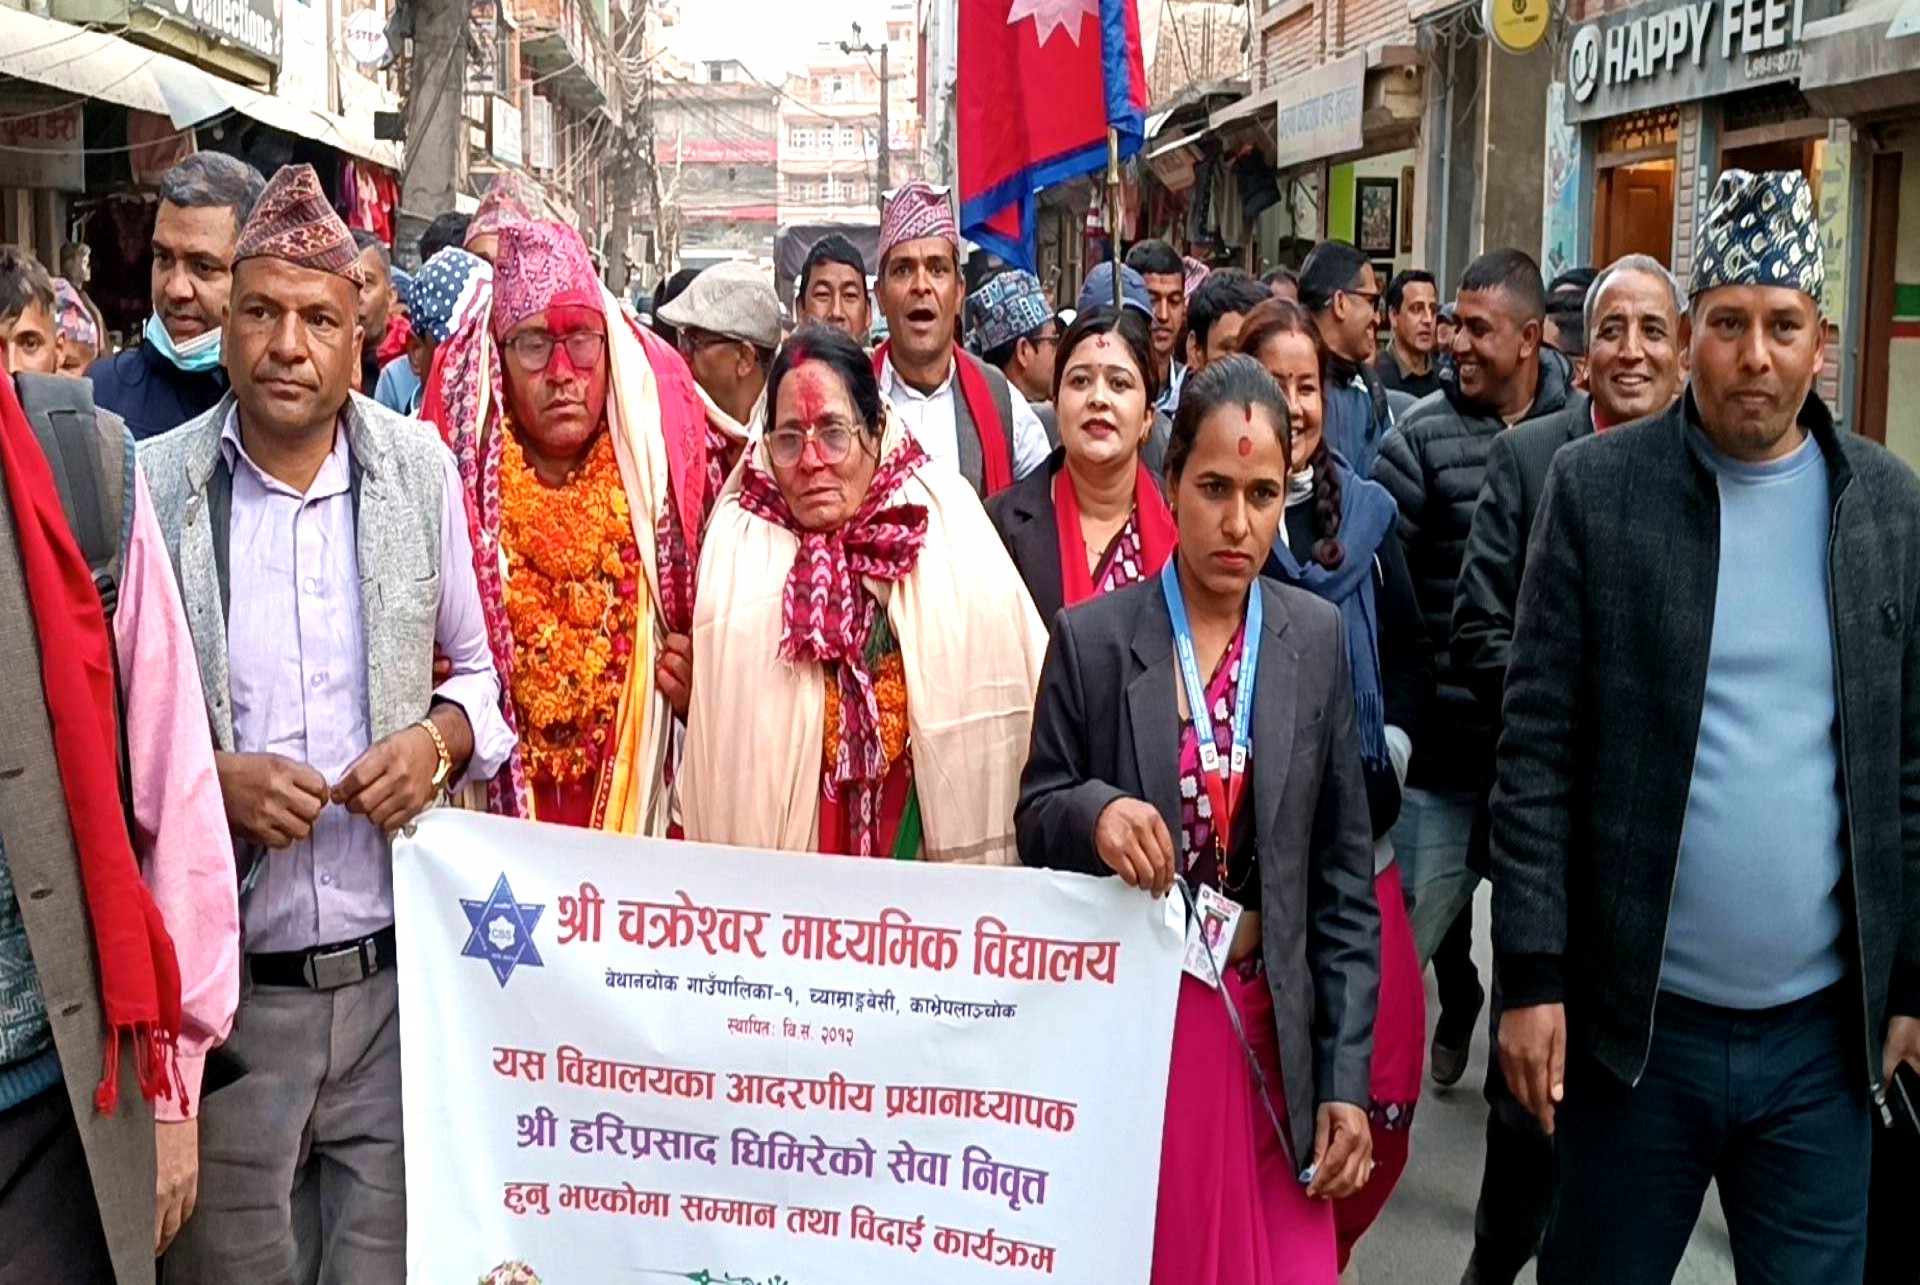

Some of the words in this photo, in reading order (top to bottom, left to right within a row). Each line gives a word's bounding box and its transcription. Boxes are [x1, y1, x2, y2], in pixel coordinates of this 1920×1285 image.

[1604, 2, 1712, 85] HAPPY
[1722, 0, 1803, 58] FEET
[557, 882, 605, 945] श्री
[618, 889, 770, 958] चक्रेश्वर
[782, 907, 962, 972] माध्यमिक
[974, 916, 1120, 984] विद्यालय
[821, 1026, 854, 1046] २०१२
[493, 1046, 546, 1082] यस
[556, 1045, 716, 1100] विद्यालयका
[726, 1072, 875, 1112] आदरणीय
[886, 1084, 1078, 1132] प्रधानाध्यापक
[516, 1106, 559, 1148] श्री
[570, 1112, 719, 1165] हरिप्रसाद
[731, 1127, 877, 1178] घिमिरेको
[888, 1140, 951, 1186] सेवा
[962, 1145, 1049, 1211] निवृत्त
[503, 1182, 551, 1215] हुनु
[560, 1181, 671, 1217] भएकोमा
[681, 1194, 778, 1229] सम्मान
[787, 1206, 841, 1236] तथा
[850, 1205, 926, 1253] विदाई
[933, 1225, 1057, 1274] कार्यक्रम
